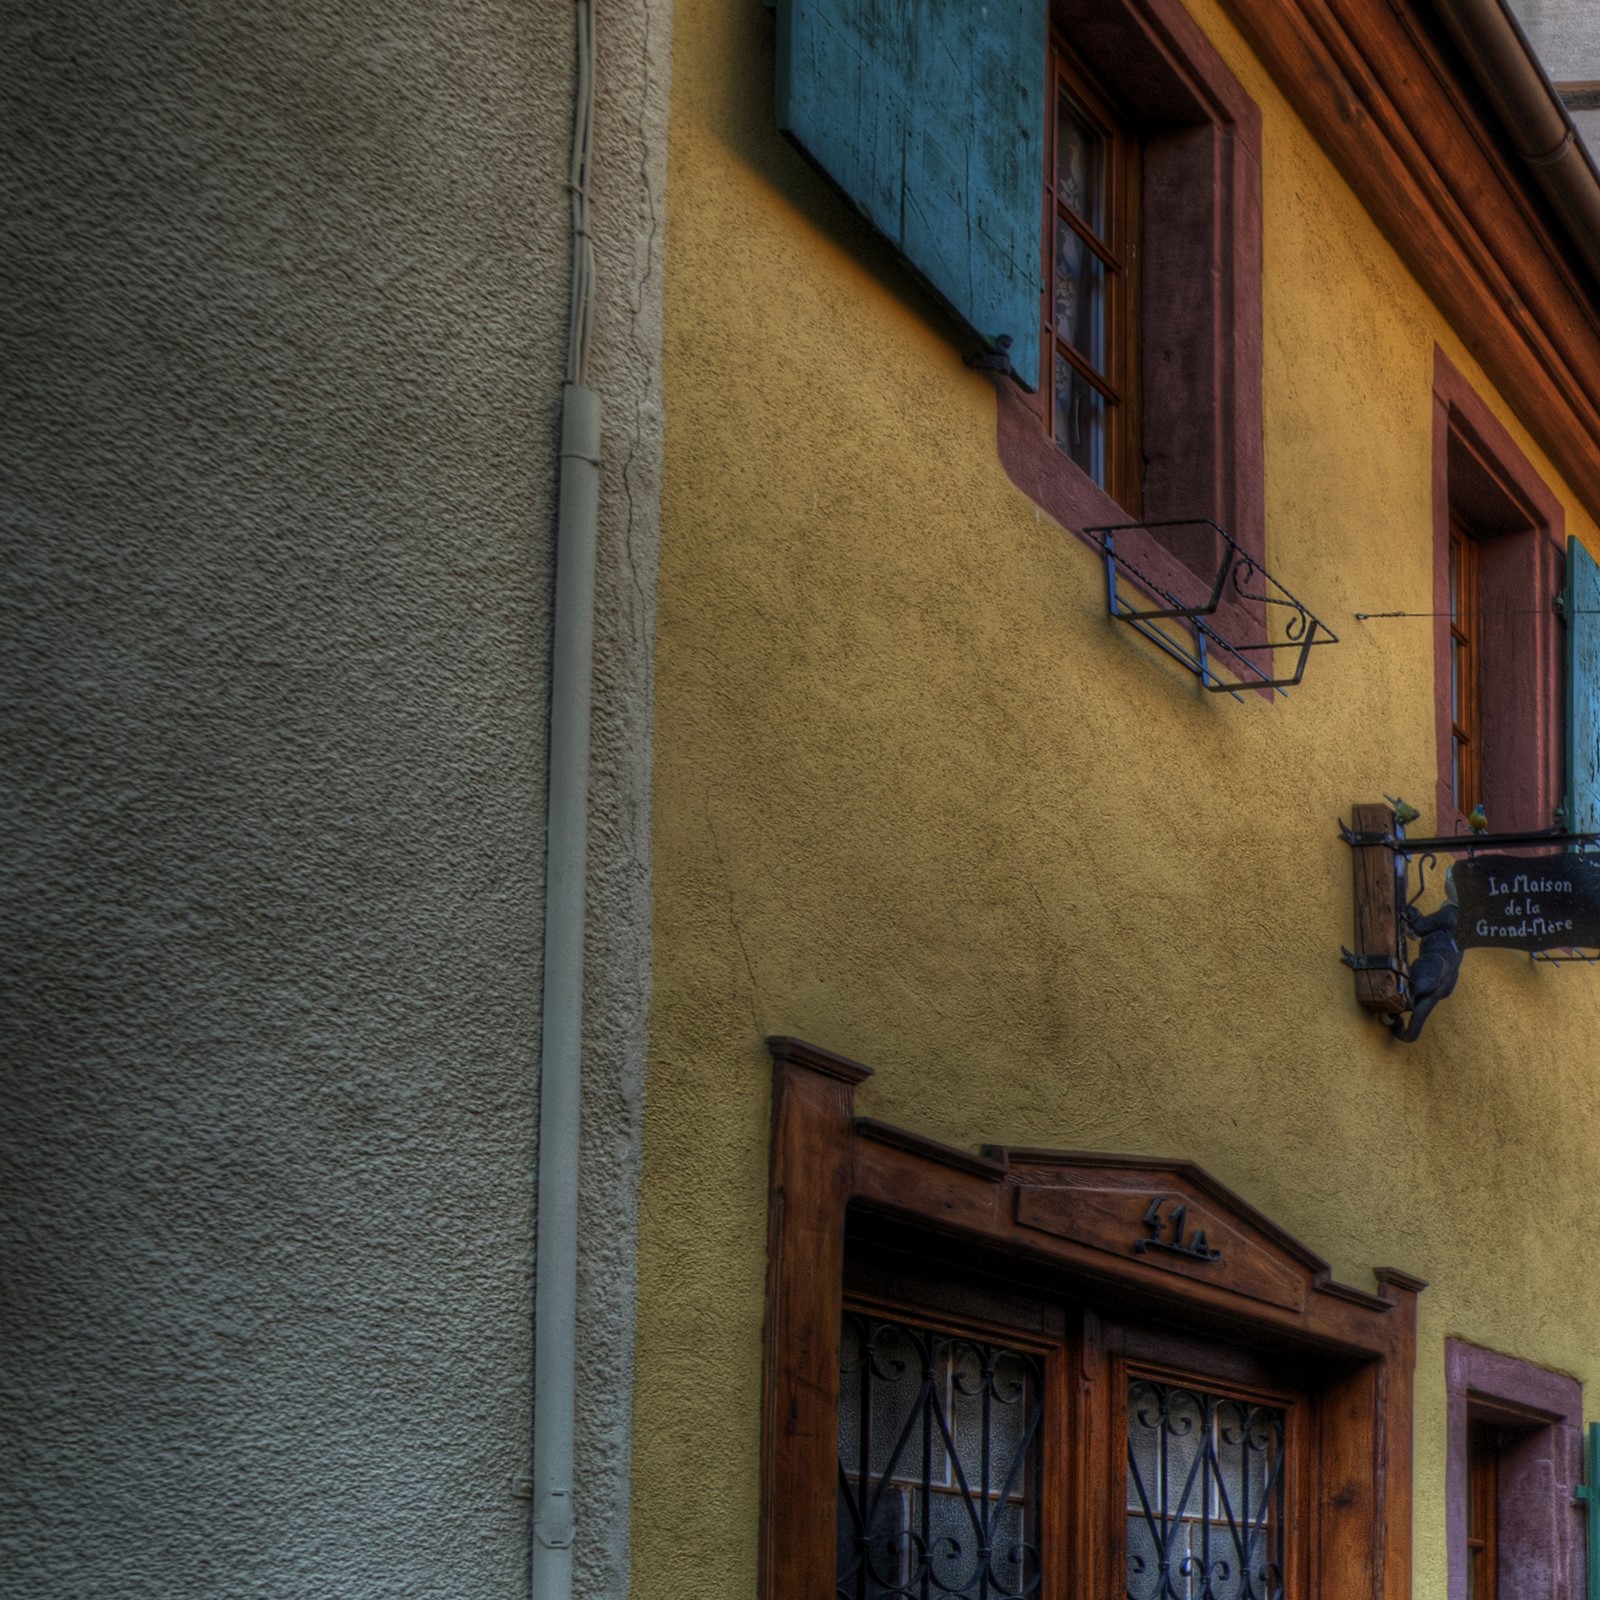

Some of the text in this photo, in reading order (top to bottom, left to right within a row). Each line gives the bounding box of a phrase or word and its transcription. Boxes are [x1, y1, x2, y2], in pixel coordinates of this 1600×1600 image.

[1488, 874, 1573, 896] La Maison
[1504, 898, 1541, 916] de la
[1476, 918, 1573, 937] Grand-Mère
